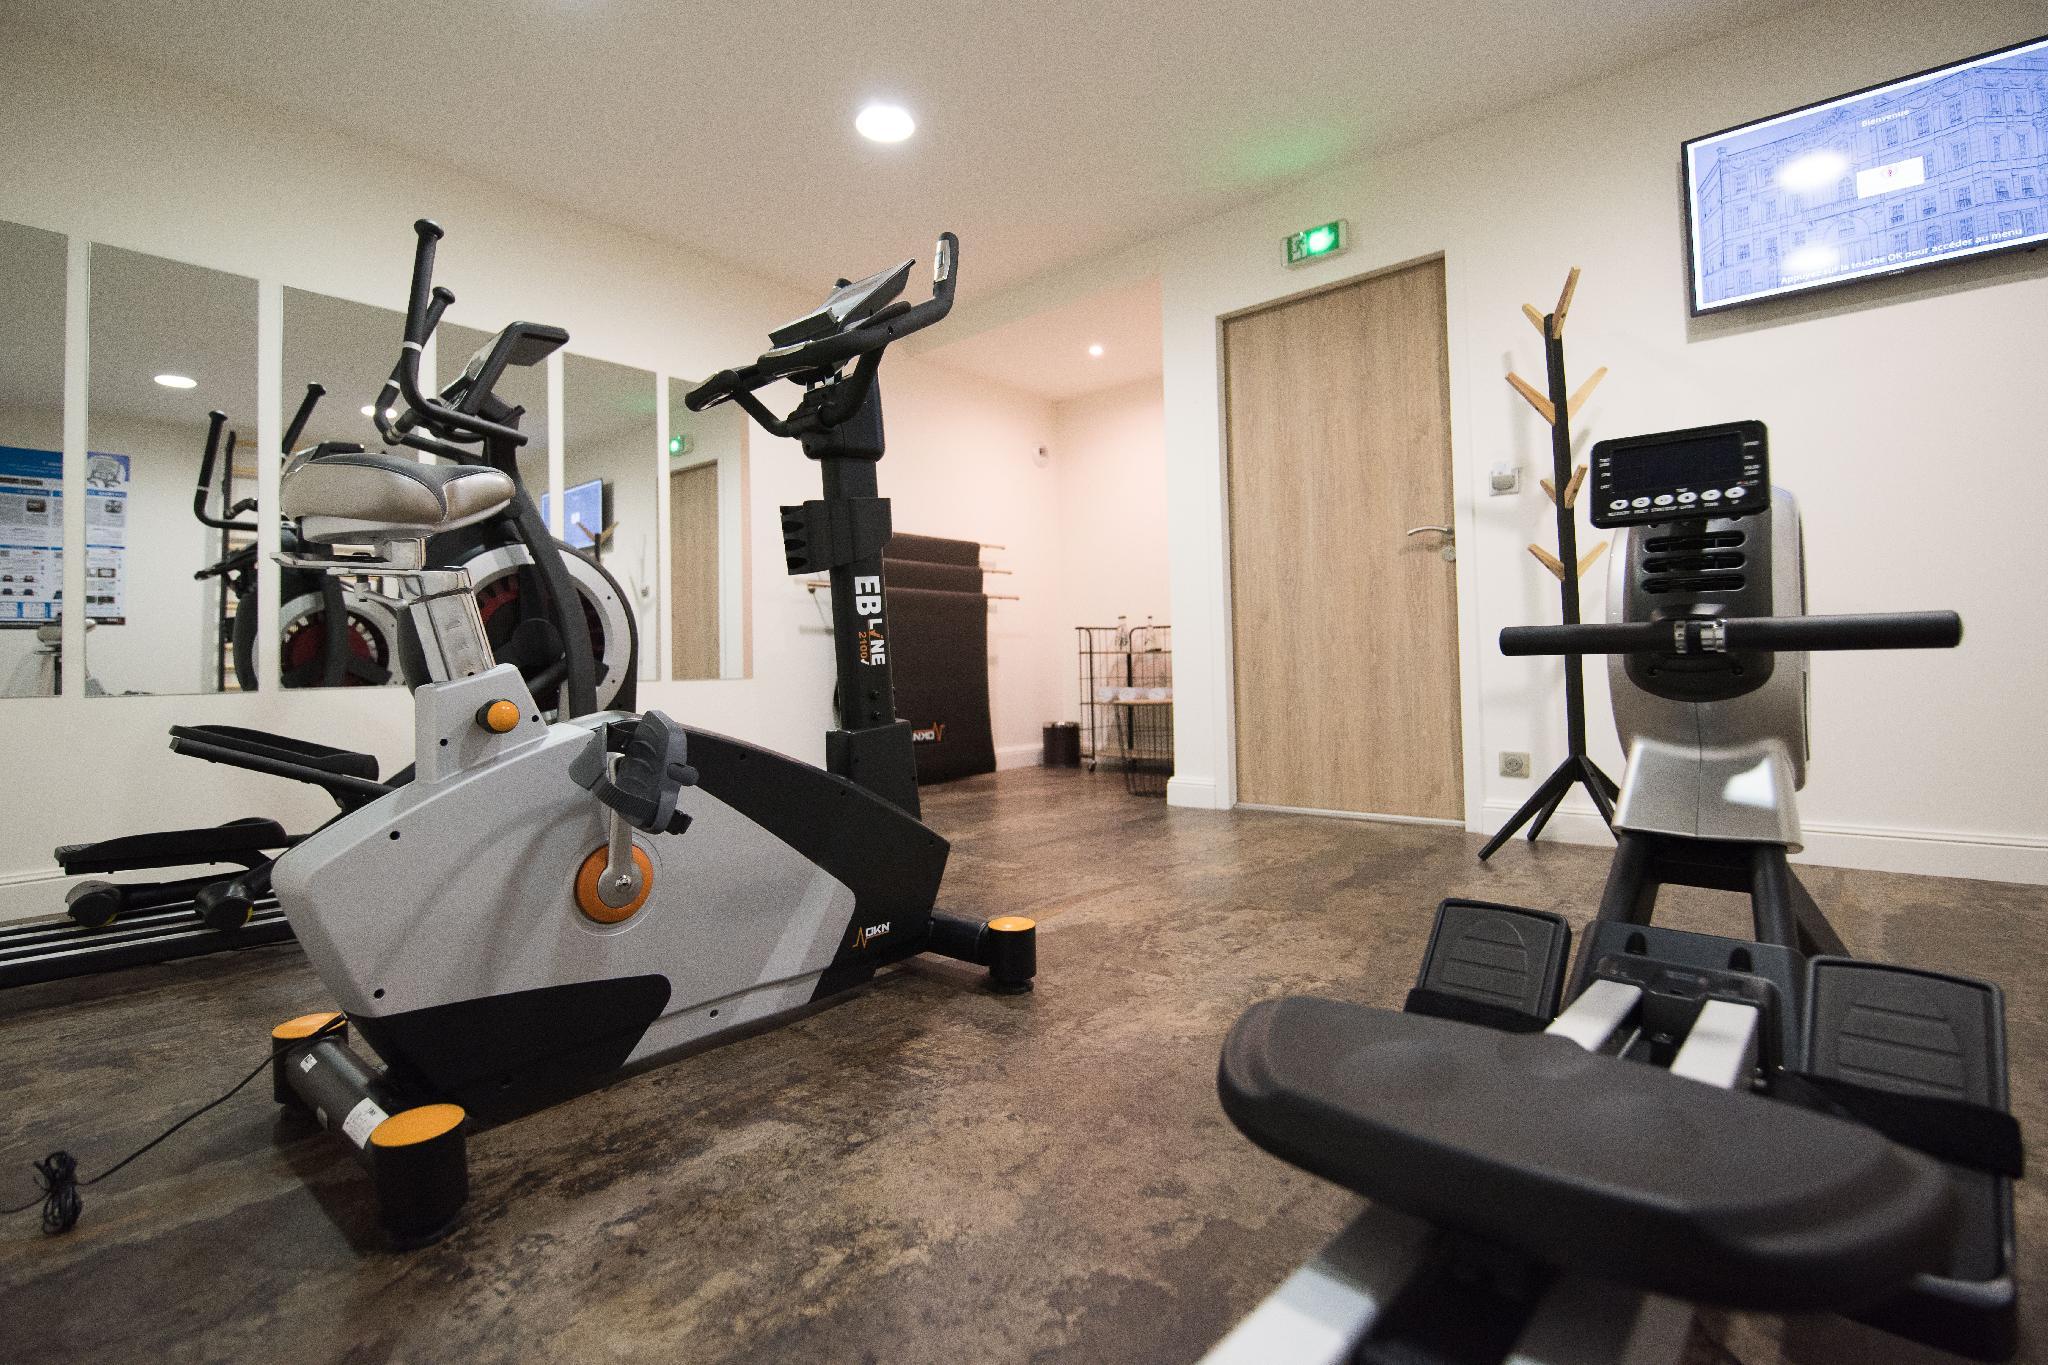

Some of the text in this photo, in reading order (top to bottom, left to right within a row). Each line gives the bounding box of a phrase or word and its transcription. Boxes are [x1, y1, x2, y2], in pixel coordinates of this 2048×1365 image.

[1861, 110, 1910, 127] Bienvenue
[1851, 257, 1886, 270] touche
[1887, 252, 1903, 262] OK
[1905, 247, 1929, 260] pour
[1931, 238, 1973, 252] accéder
[1975, 235, 1989, 244] au
[1991, 228, 2022, 240] menu
[865, 921, 890, 938] DKN
